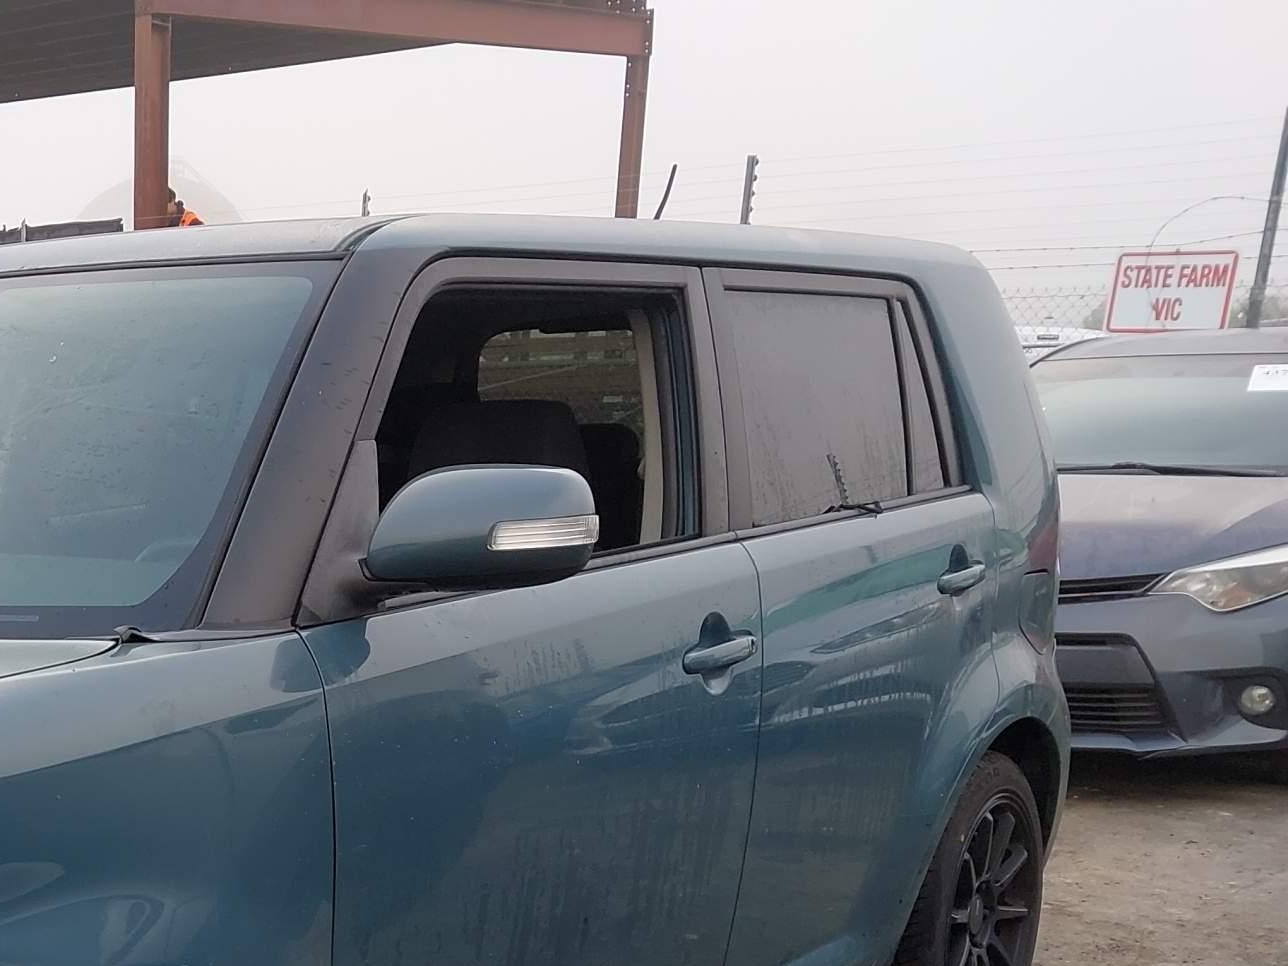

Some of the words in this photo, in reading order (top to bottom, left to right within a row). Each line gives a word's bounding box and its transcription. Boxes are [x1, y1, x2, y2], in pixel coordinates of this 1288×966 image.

[1121, 264, 1175, 289] STATE
[1177, 263, 1229, 288] FARM
[1154, 297, 1183, 321] VIC
